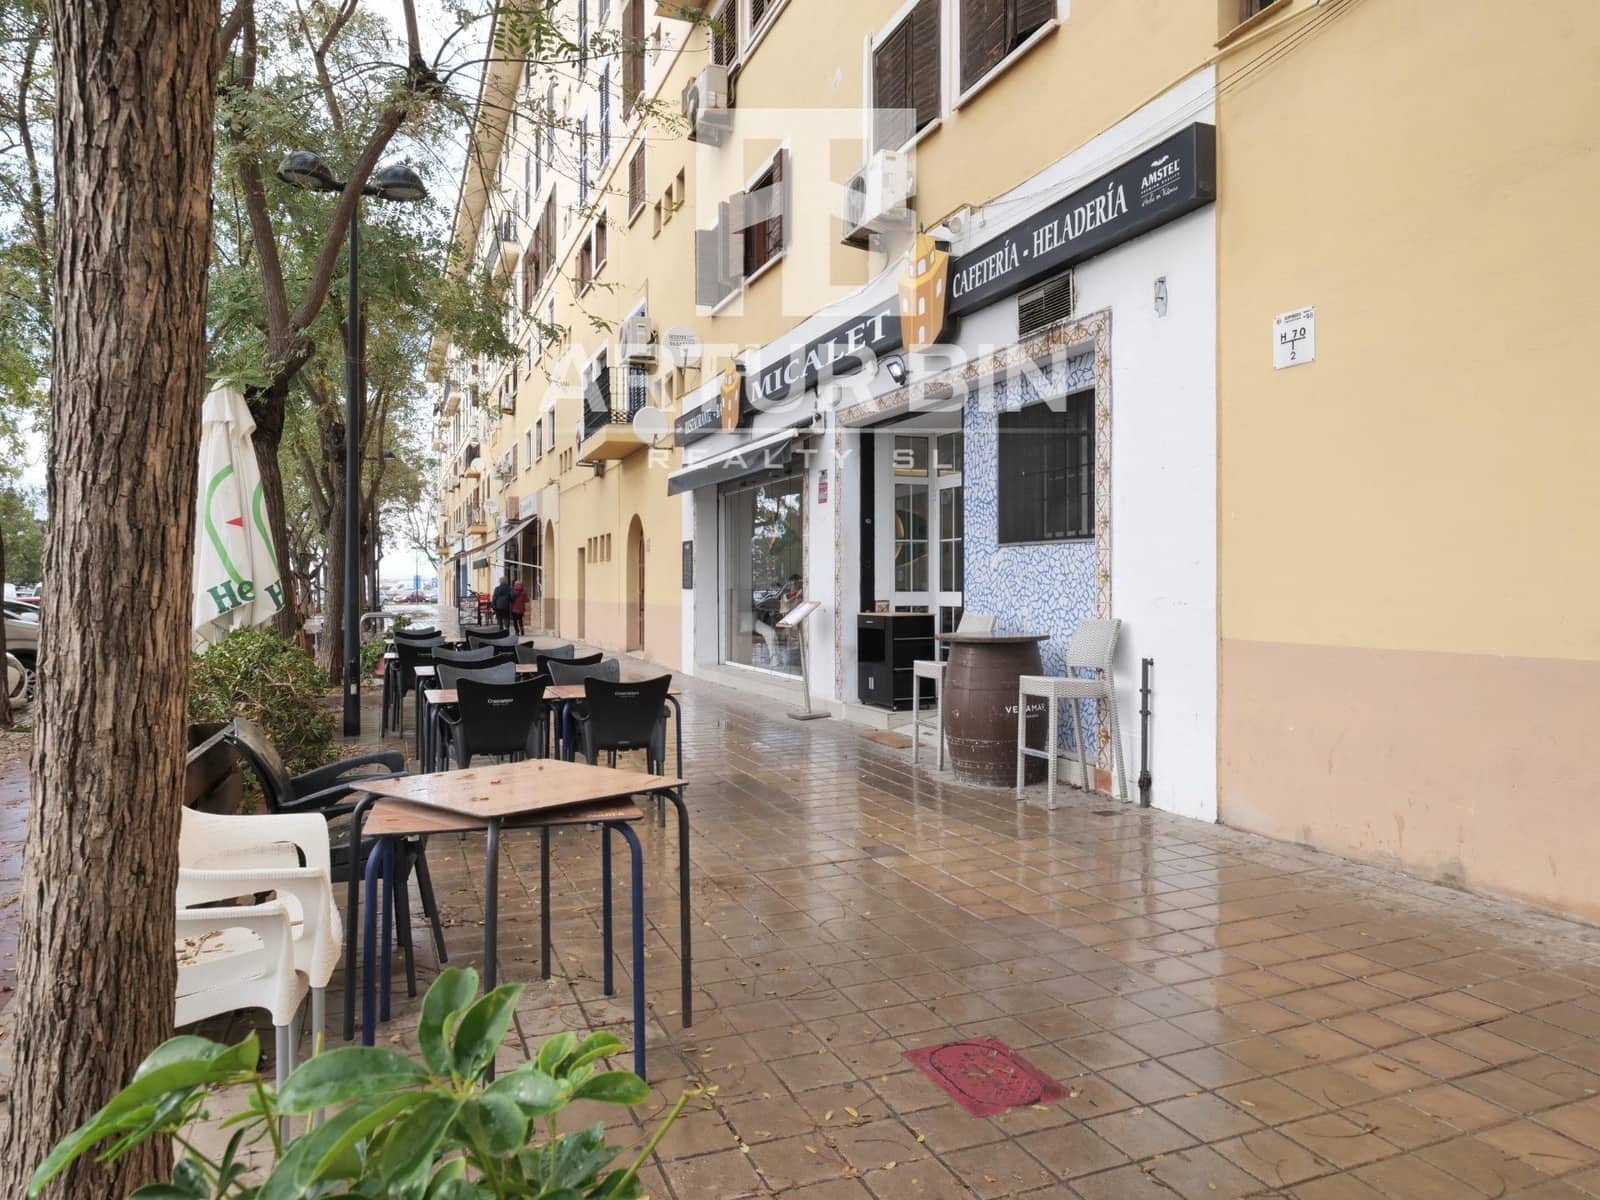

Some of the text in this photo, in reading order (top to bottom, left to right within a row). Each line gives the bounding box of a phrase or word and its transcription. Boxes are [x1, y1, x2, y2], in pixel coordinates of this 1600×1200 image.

[1141, 160, 1180, 190] AMSTEL
[952, 240, 1020, 298] CAFETERÍA
[1032, 182, 1128, 259] HELADERÍA
[752, 309, 891, 402] MICALET
[1280, 331, 1287, 343] H
